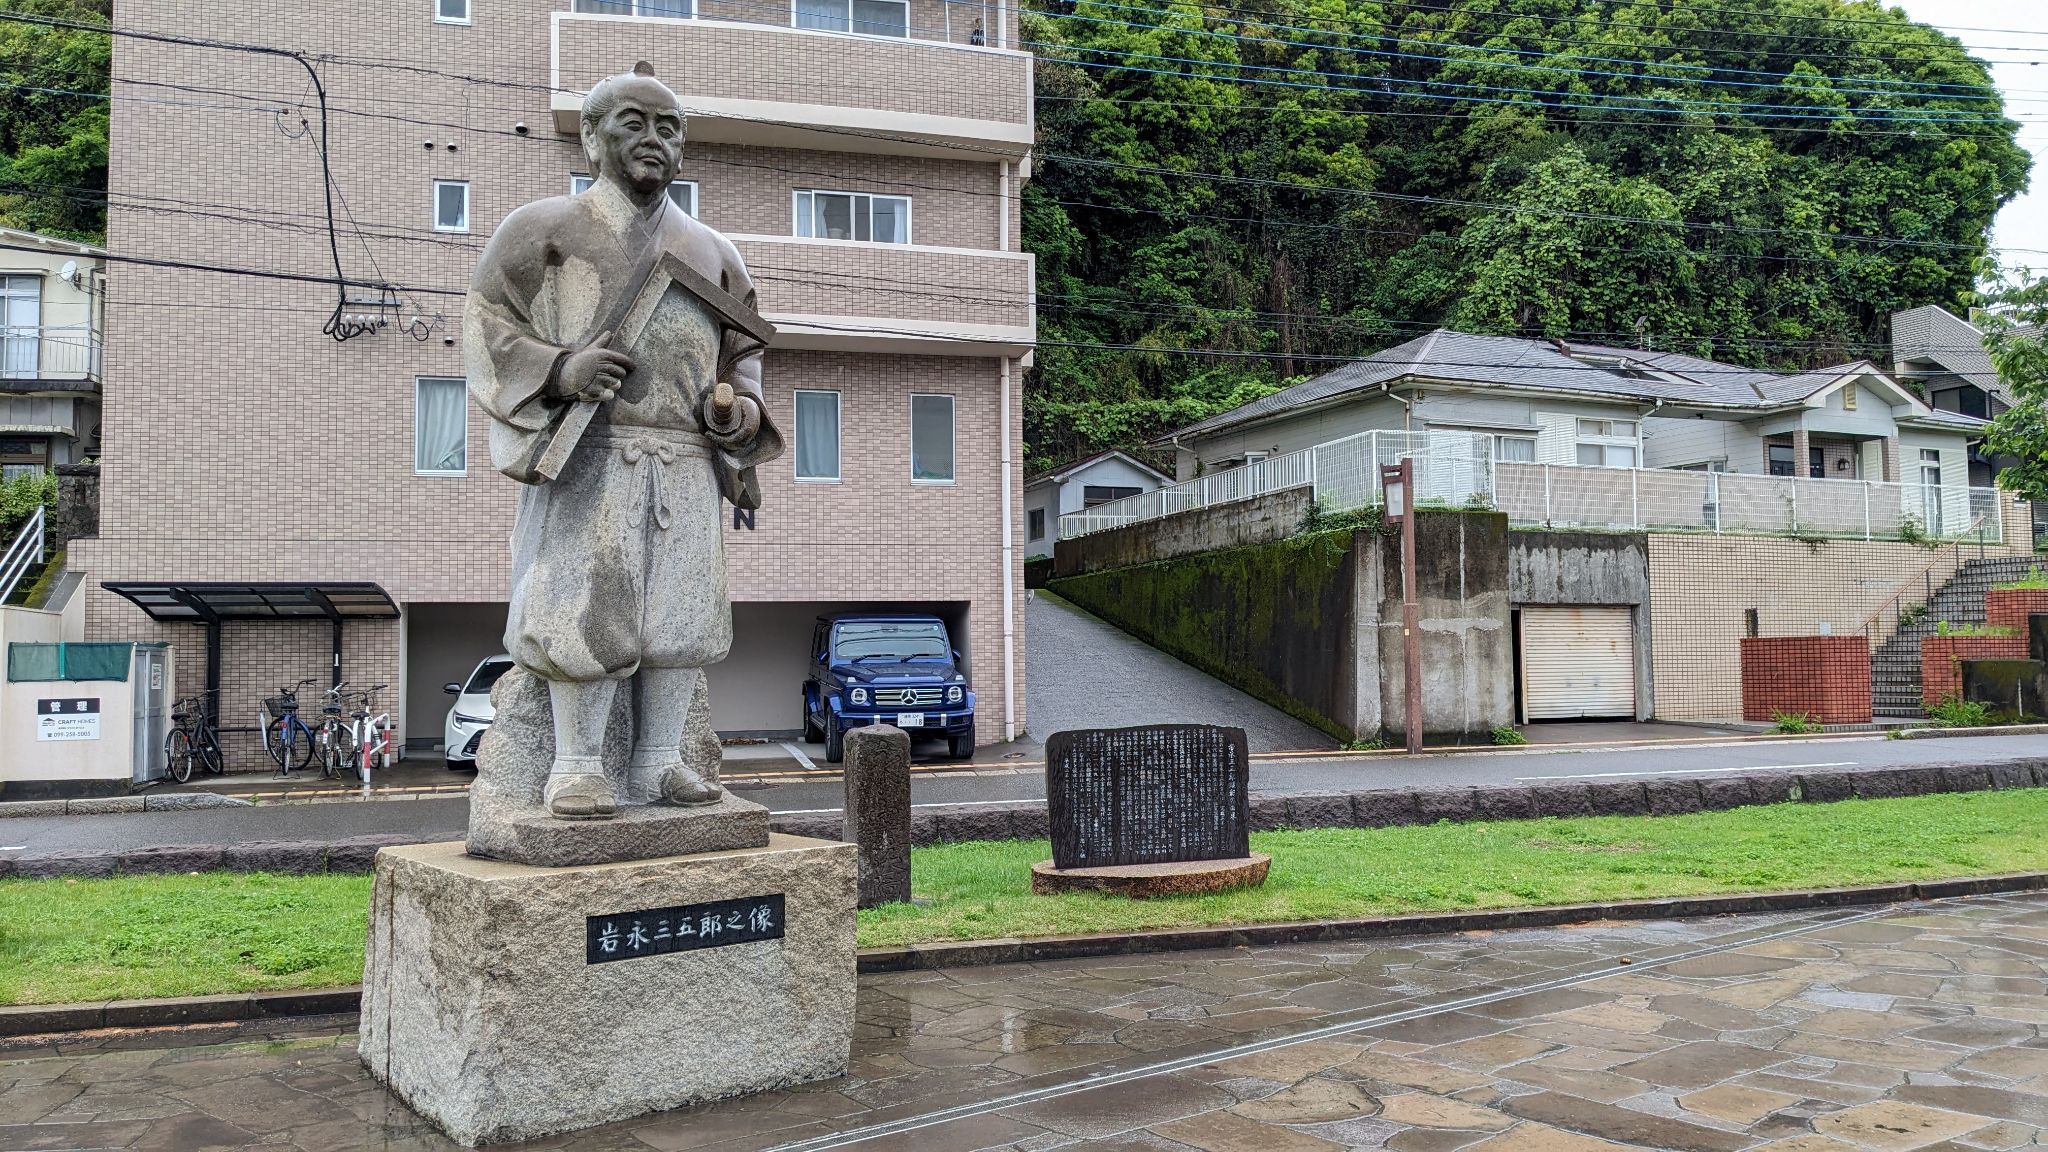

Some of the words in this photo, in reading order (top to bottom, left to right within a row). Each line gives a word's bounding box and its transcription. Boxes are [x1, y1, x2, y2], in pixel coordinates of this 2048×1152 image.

[734, 507, 754, 530] N
[597, 904, 776, 953] 岩永三五郎之像
